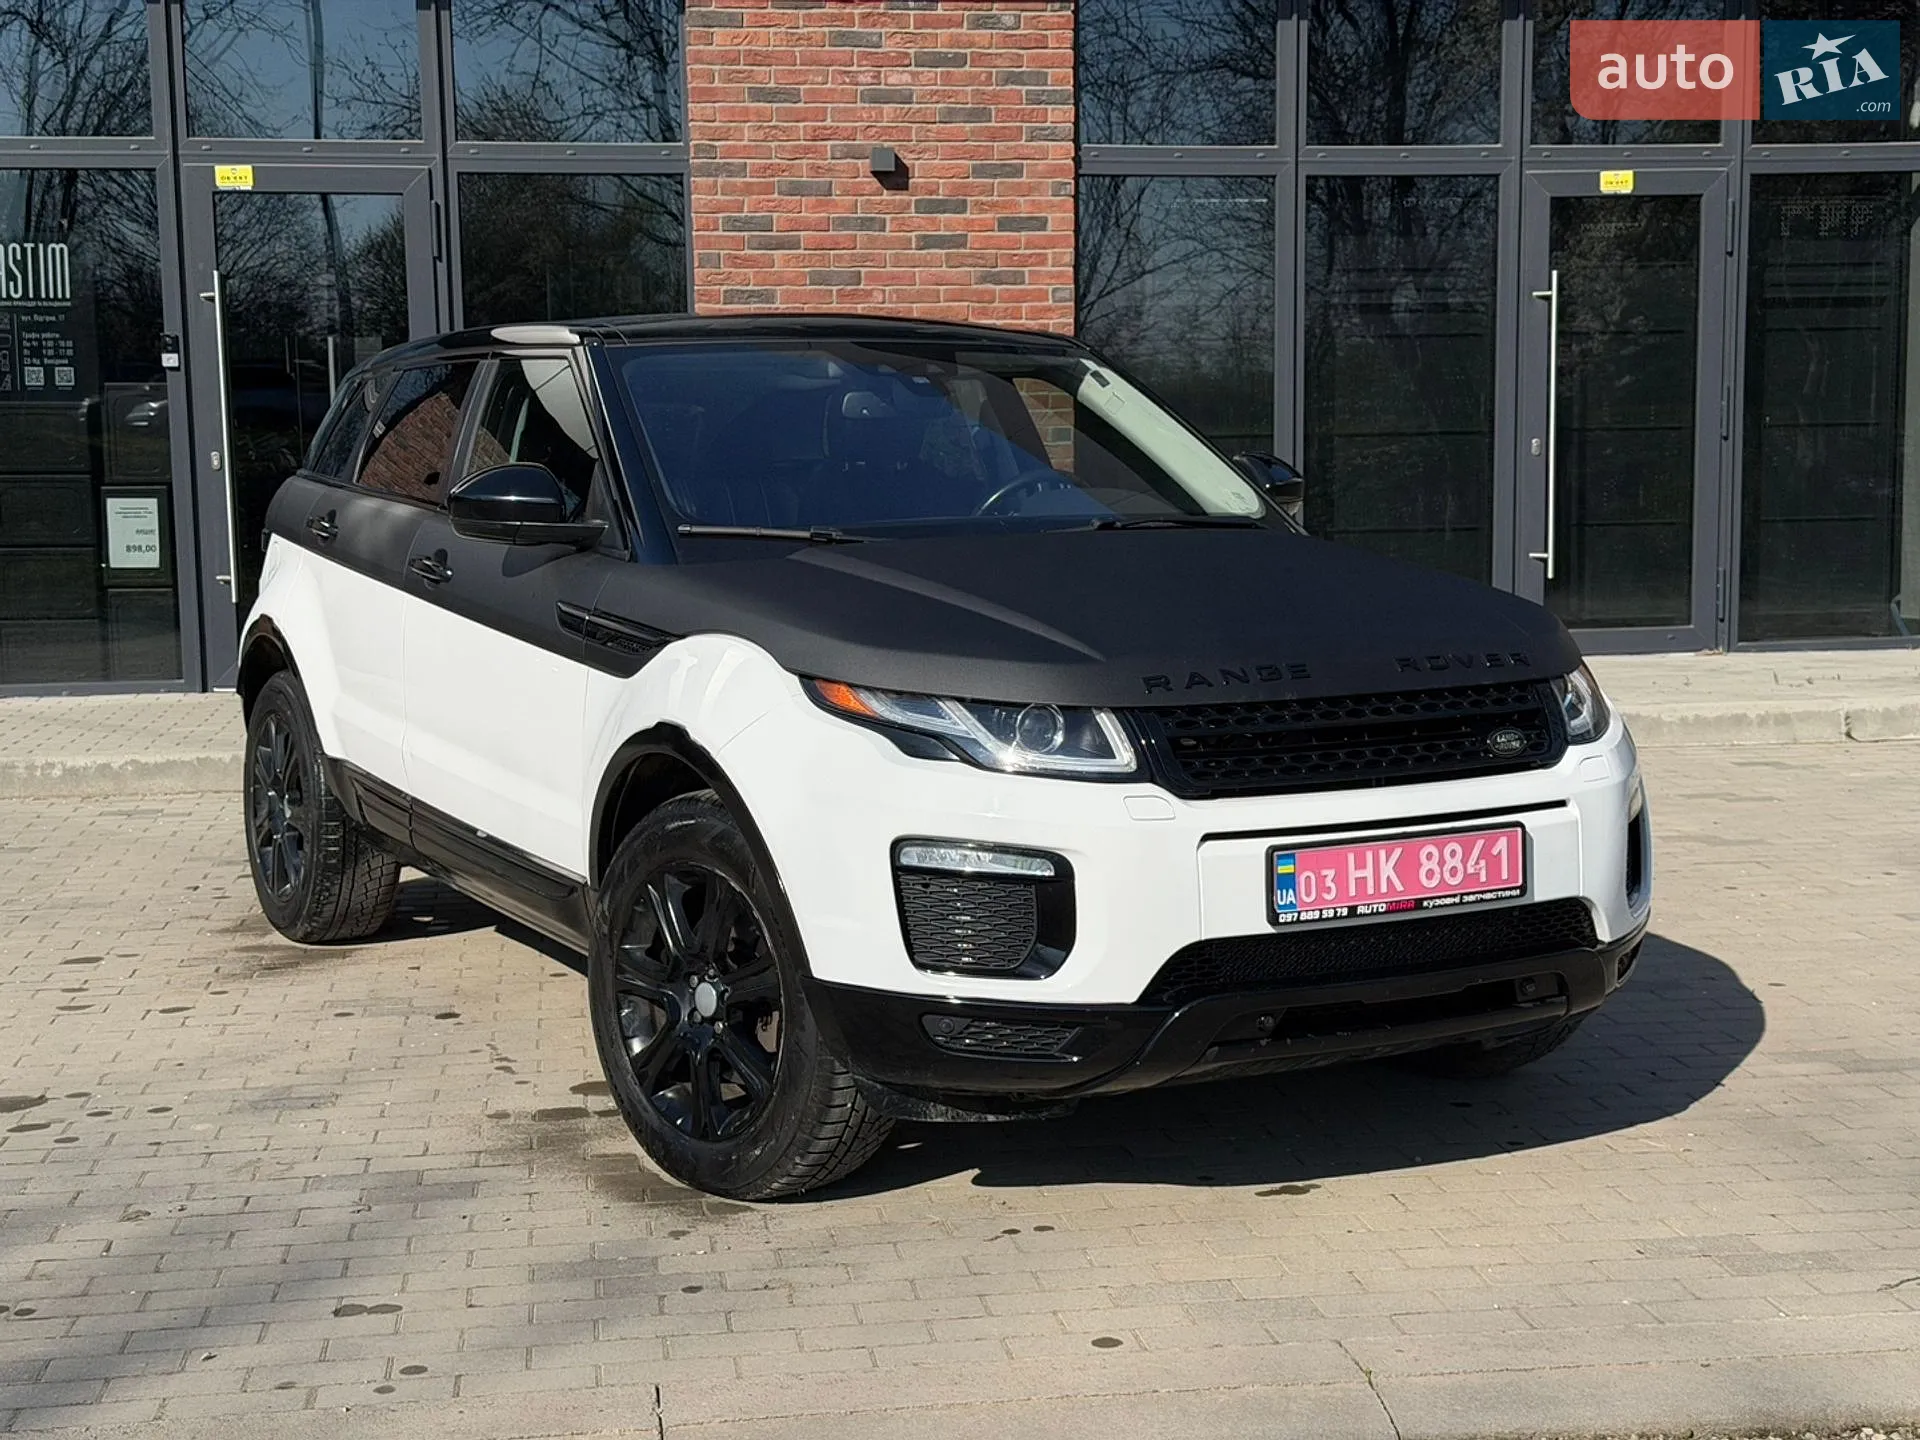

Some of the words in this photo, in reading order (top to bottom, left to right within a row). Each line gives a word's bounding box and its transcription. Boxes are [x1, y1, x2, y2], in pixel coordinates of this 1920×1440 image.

[1142, 663, 1312, 693] RANGE
[1393, 652, 1531, 673] ROVER
[1277, 888, 1296, 906] UA
[1299, 868, 1338, 903] 03
[1347, 847, 1404, 897] HK
[1418, 836, 1508, 888] 8841
[1279, 912, 1299, 923] 097
[1300, 910, 1321, 921] 889
[1321, 908, 1336, 918] 59
[1336, 907, 1349, 917] 79
